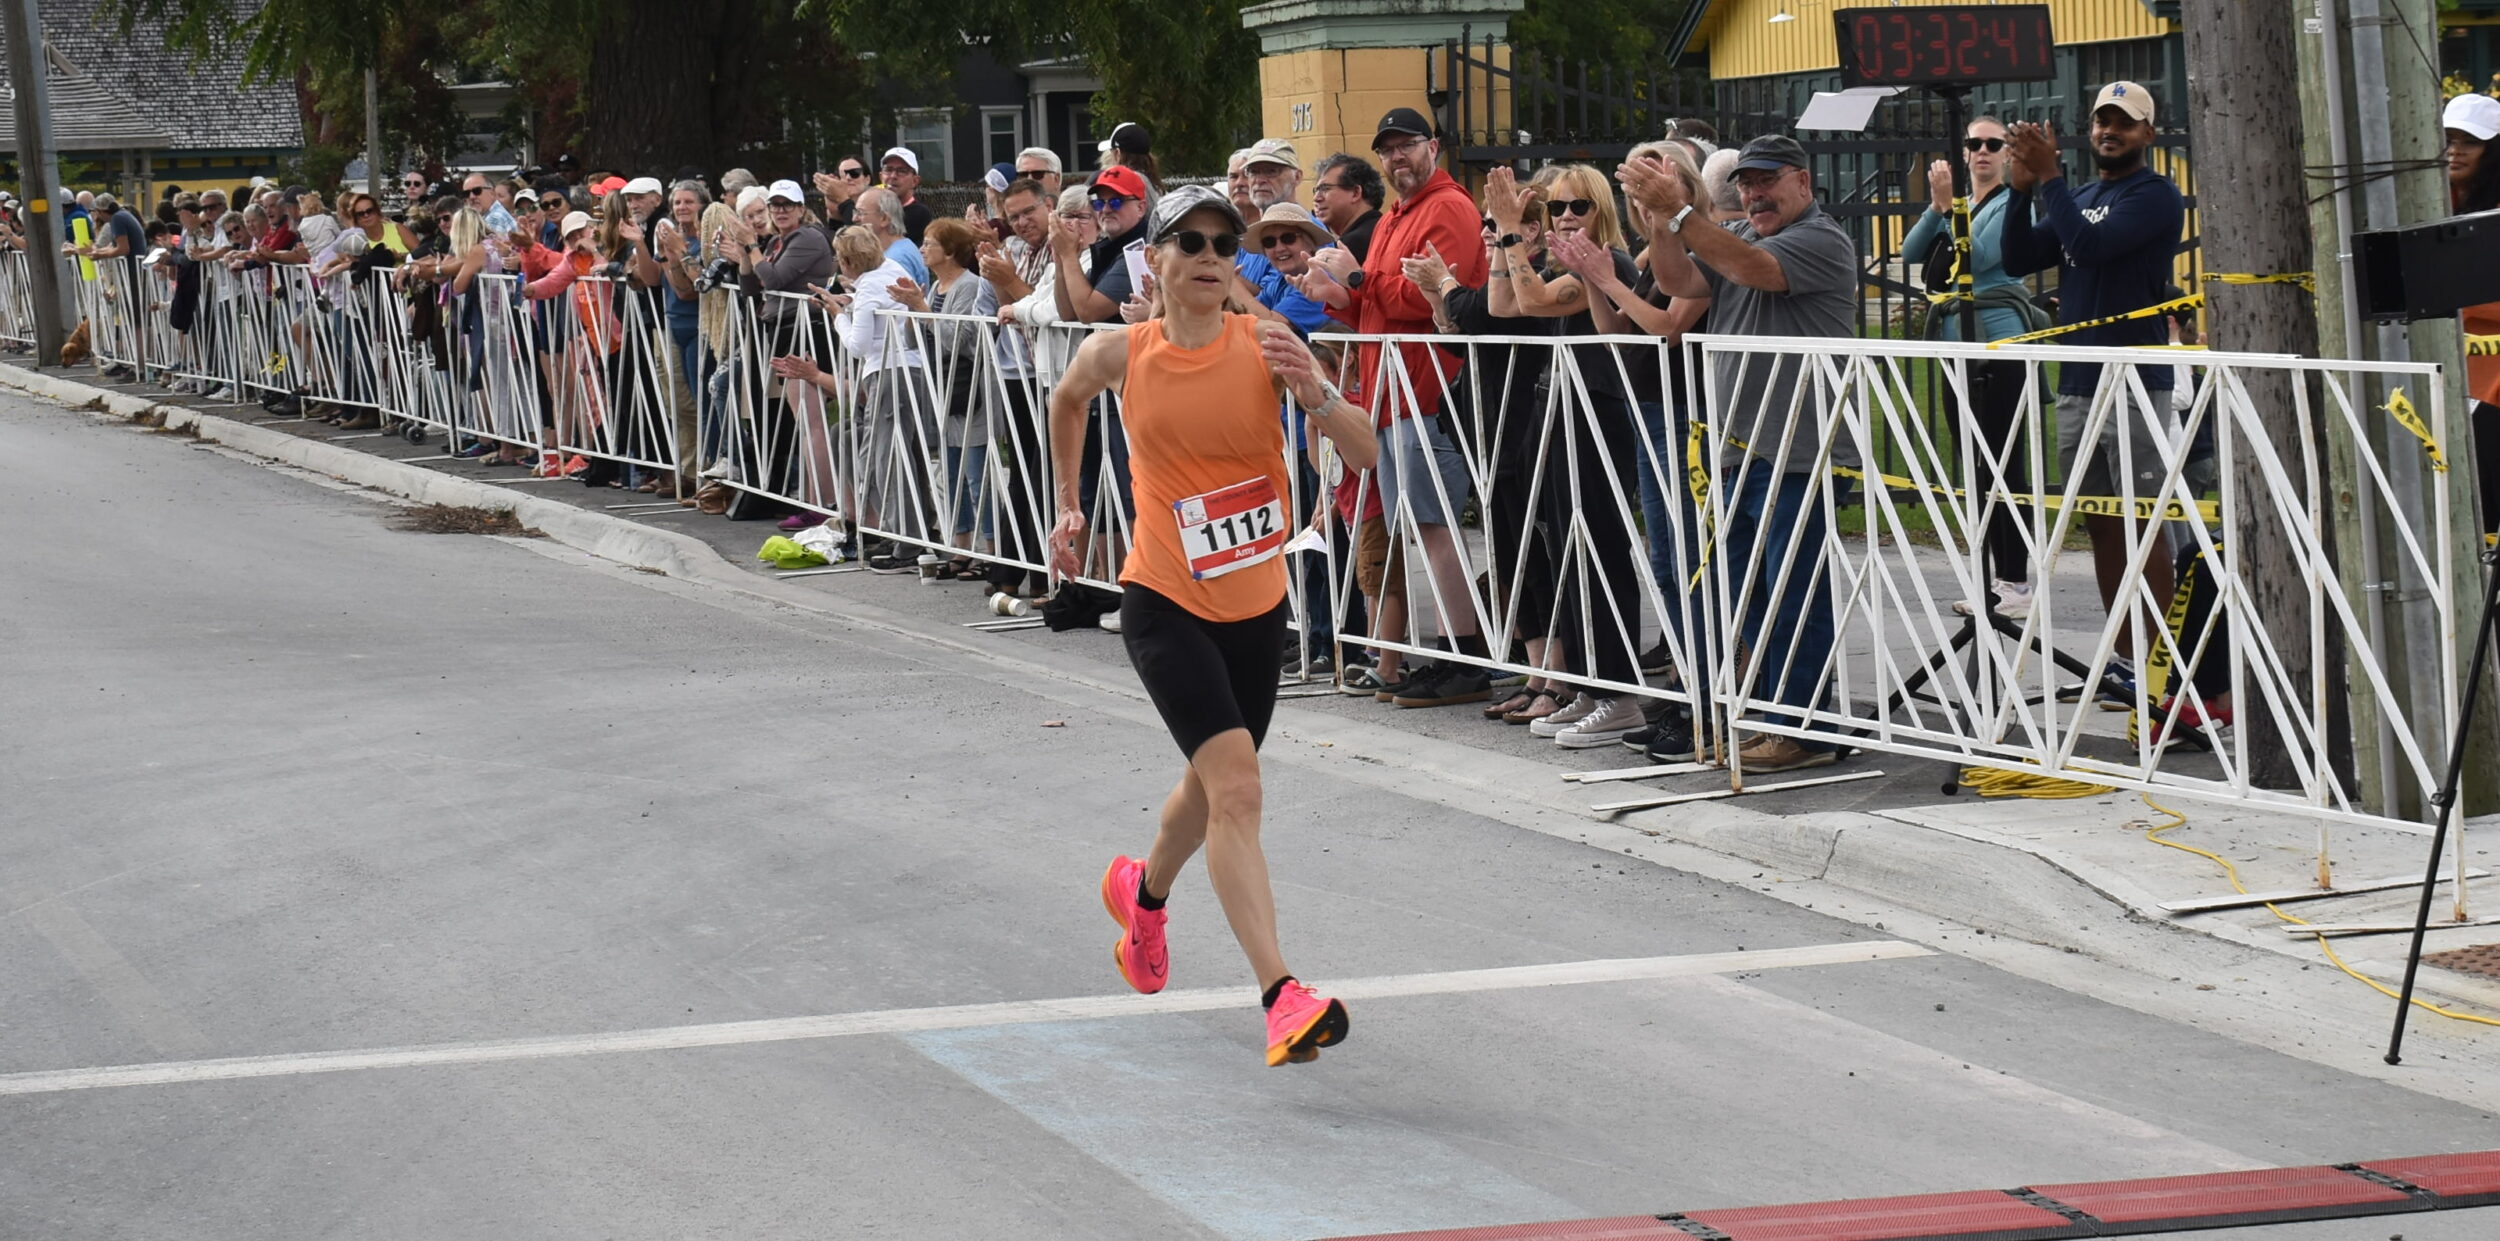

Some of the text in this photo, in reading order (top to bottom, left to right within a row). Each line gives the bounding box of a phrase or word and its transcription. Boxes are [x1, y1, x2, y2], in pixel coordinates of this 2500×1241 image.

[1855, 13, 2048, 78] 03:32:41
[2112, 83, 2127, 97] LA
[1200, 506, 1273, 552] 1112
[1234, 546, 1256, 559] Amy
